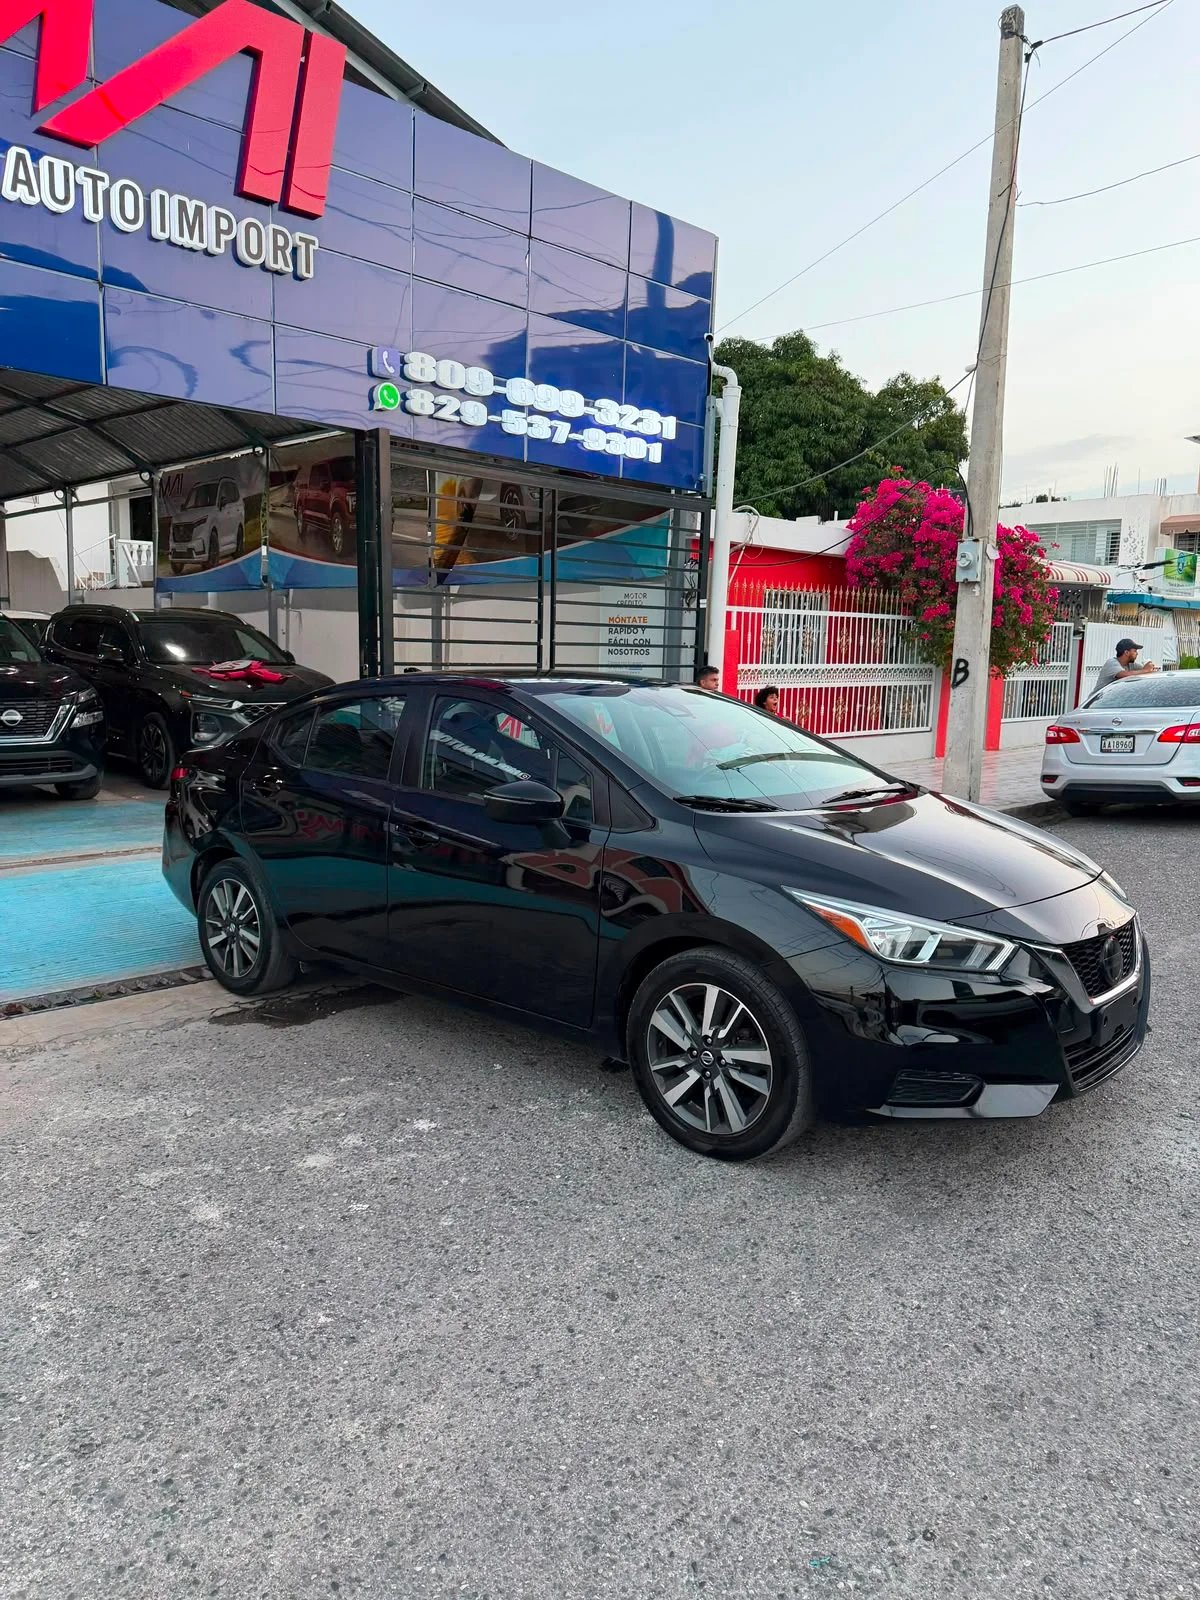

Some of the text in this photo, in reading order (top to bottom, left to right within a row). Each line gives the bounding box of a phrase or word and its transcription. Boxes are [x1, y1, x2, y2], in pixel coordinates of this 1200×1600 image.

[403, 351, 677, 440] 809-699-3231
[404, 389, 663, 463] 829-537-9301
[608, 614, 648, 624] MÓNTATE
[640, 627, 646, 635] Y
[632, 638, 651, 646] CON
[607, 648, 650, 656] NOSOTROS
[951, 658, 970, 690] B
[1102, 740, 1133, 749] AA18960
